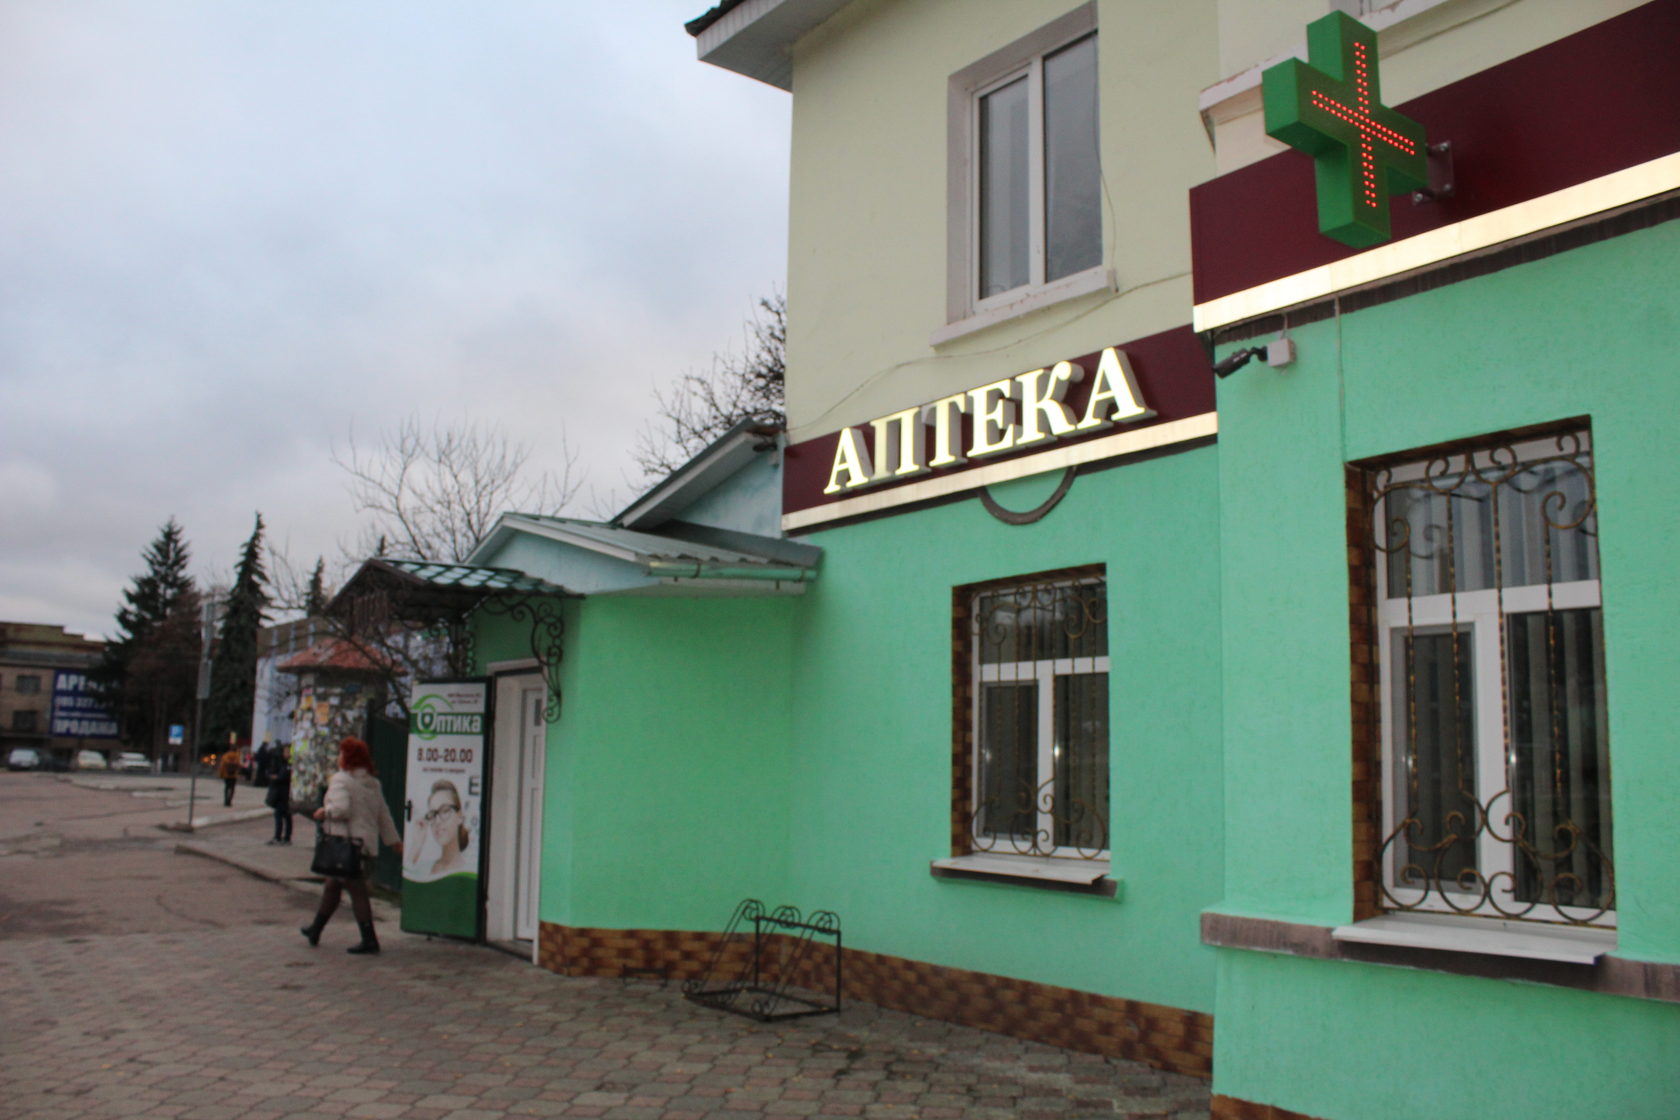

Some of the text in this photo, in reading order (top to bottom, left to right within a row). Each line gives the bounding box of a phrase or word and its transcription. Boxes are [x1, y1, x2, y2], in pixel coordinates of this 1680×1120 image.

[822, 345, 1152, 495] АПТЕКА
[416, 709, 482, 734] Оптика
[417, 747, 473, 764] 8.00-20.00
